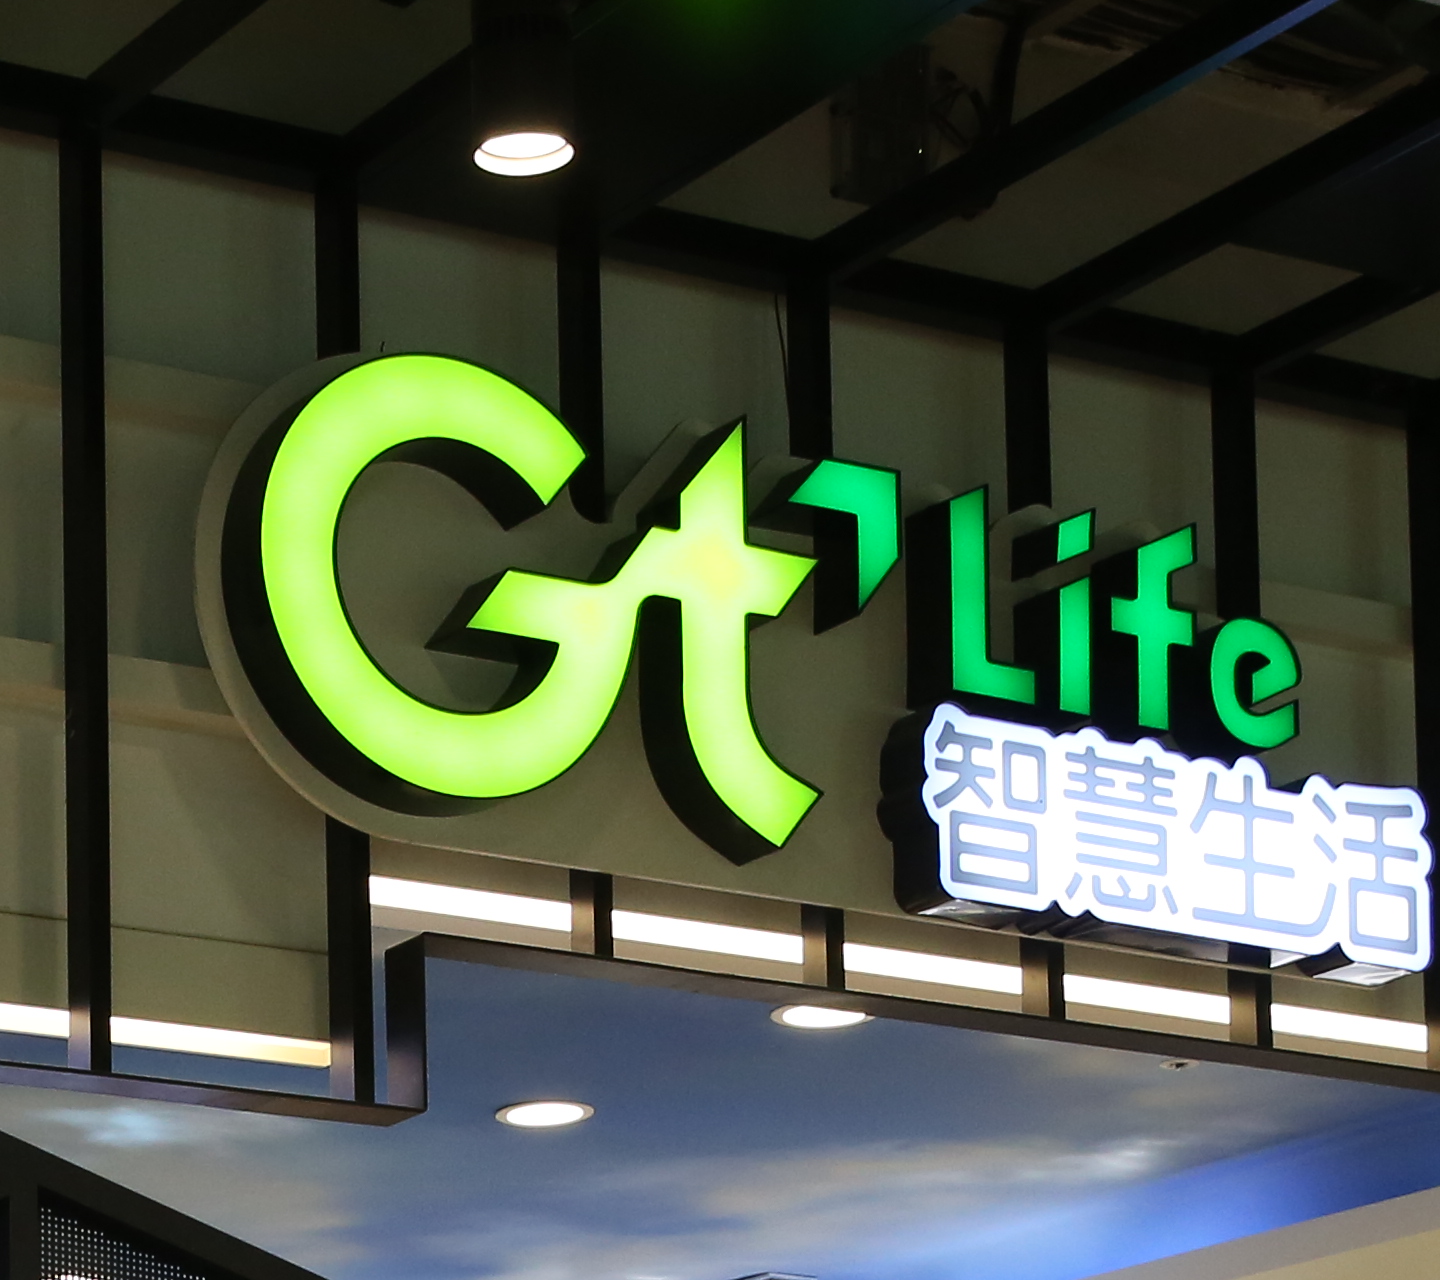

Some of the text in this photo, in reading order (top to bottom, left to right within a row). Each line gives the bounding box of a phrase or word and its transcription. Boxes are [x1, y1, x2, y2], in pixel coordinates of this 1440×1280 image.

[259, 352, 824, 850] Gt
[948, 484, 1302, 750] Life
[926, 708, 1432, 968] 智慧生活
